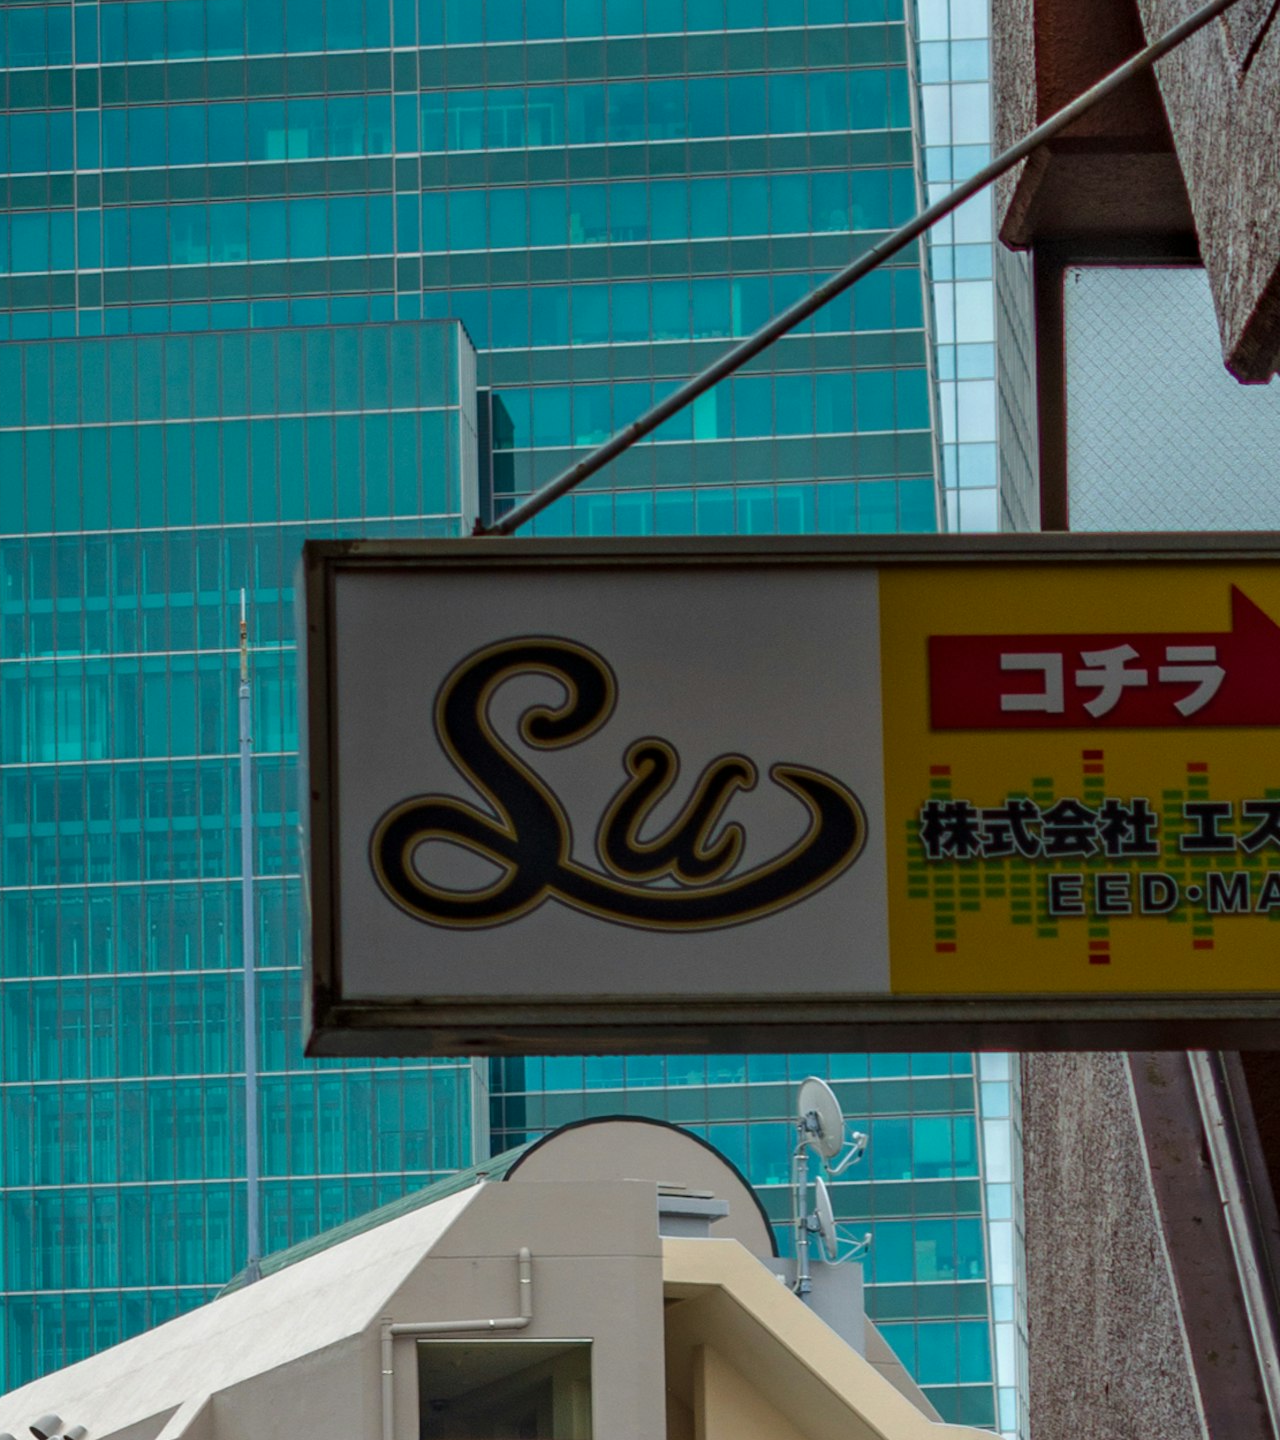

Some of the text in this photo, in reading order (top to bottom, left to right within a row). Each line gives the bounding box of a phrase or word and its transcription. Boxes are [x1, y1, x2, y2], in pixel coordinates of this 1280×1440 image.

[1000, 643, 1227, 718] コチラ
[919, 797, 1160, 858] 株式会社
